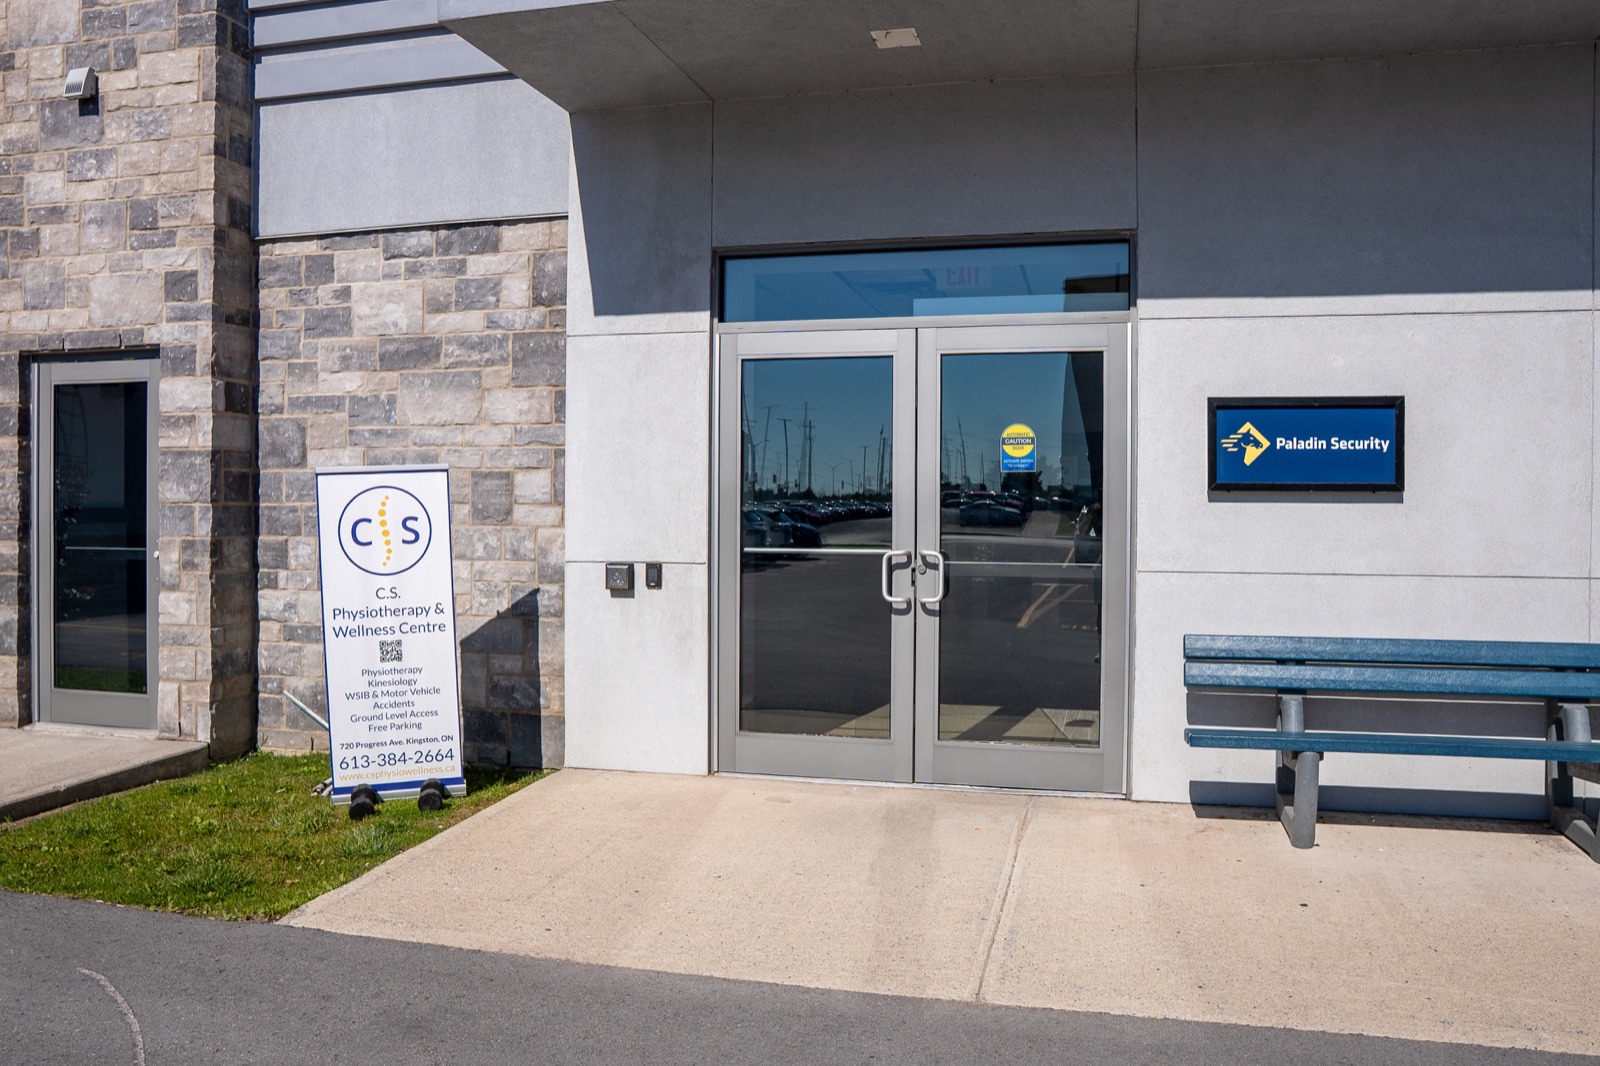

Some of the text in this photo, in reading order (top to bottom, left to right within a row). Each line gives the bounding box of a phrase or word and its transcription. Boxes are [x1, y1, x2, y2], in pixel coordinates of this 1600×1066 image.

[1276, 436, 1390, 453] Paladin Security
[376, 586, 401, 600] C.S.
[332, 602, 445, 622] Physiotherapy &
[333, 622, 446, 639] Wellness Centre
[362, 667, 423, 678] Physiotherapy
[368, 678, 418, 688] Kinesiology
[345, 687, 441, 701] WSIB & Motor Vehicle
[373, 700, 415, 710] Accidents
[350, 709, 439, 723] Ground Level Access
[369, 722, 422, 733] Free Parking
[340, 742, 354, 750] 720
[356, 740, 388, 749] Progress
[406, 737, 440, 745] Kingston,
[441, 734, 454, 742] ON
[340, 748, 455, 770] 613-384-2664
[340, 765, 456, 781] www.csphysiowellness.ca
